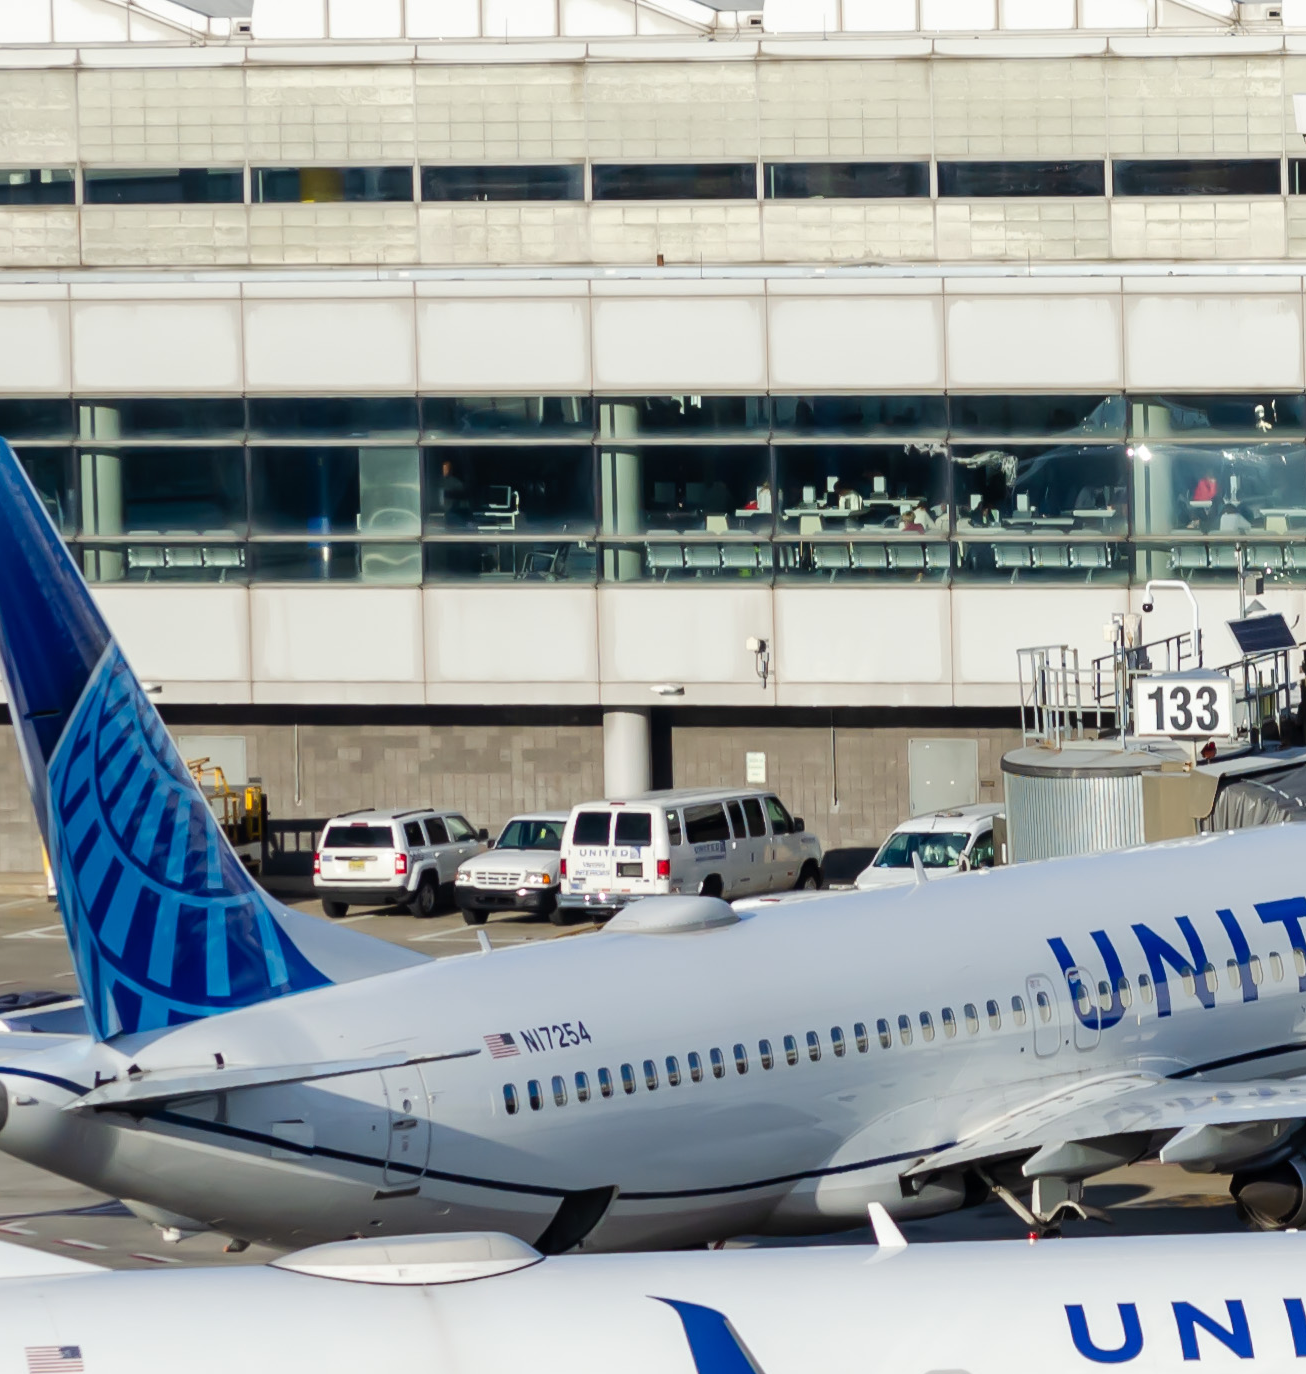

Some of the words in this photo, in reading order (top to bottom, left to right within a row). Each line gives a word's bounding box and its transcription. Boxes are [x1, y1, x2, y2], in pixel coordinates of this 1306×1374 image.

[1148, 687, 1219, 730] 133
[579, 848, 629, 857] UNITED
[521, 1020, 592, 1053] N17254
